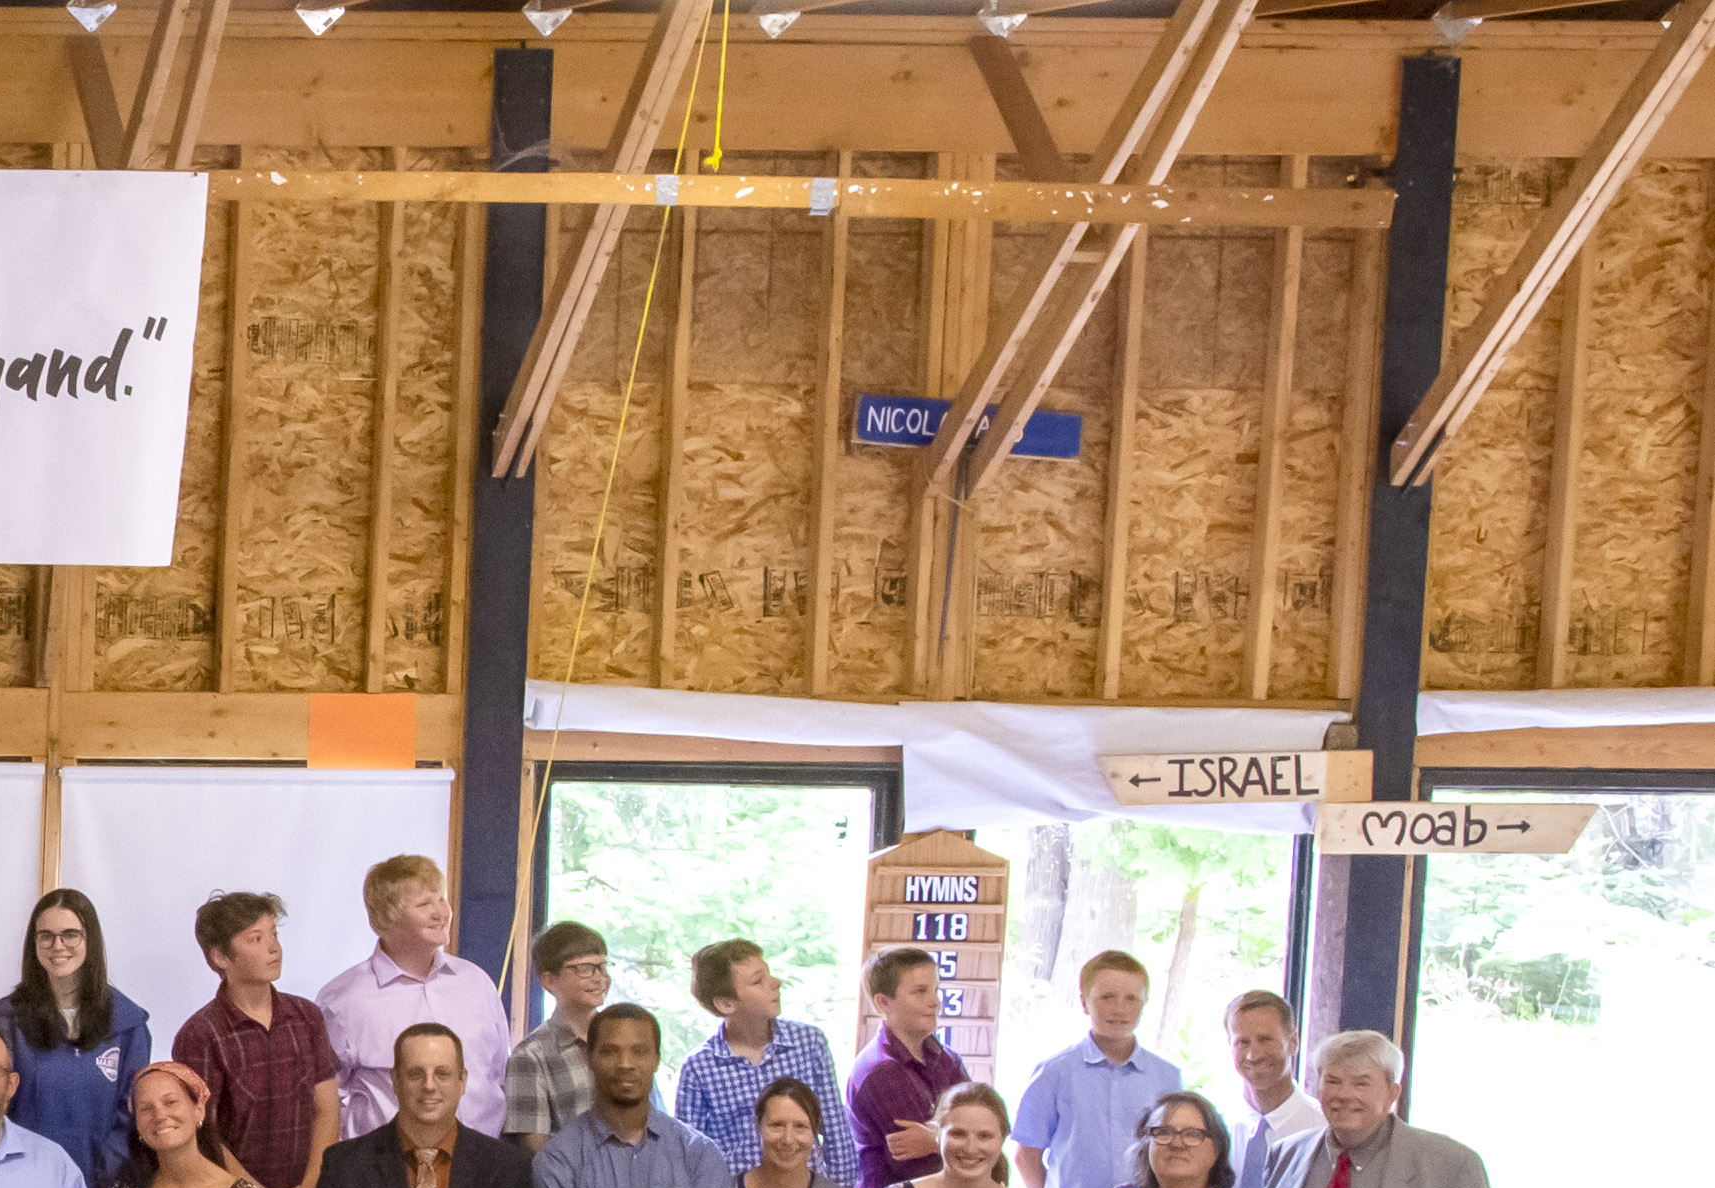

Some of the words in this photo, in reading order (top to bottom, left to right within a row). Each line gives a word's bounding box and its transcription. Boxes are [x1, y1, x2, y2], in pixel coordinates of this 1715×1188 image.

[1168, 754, 1319, 797] ISRAEL
[905, 876, 978, 903] HYMNS
[916, 913, 968, 941] 118
[928, 951, 957, 978] 5
[937, 989, 963, 1016] 3
